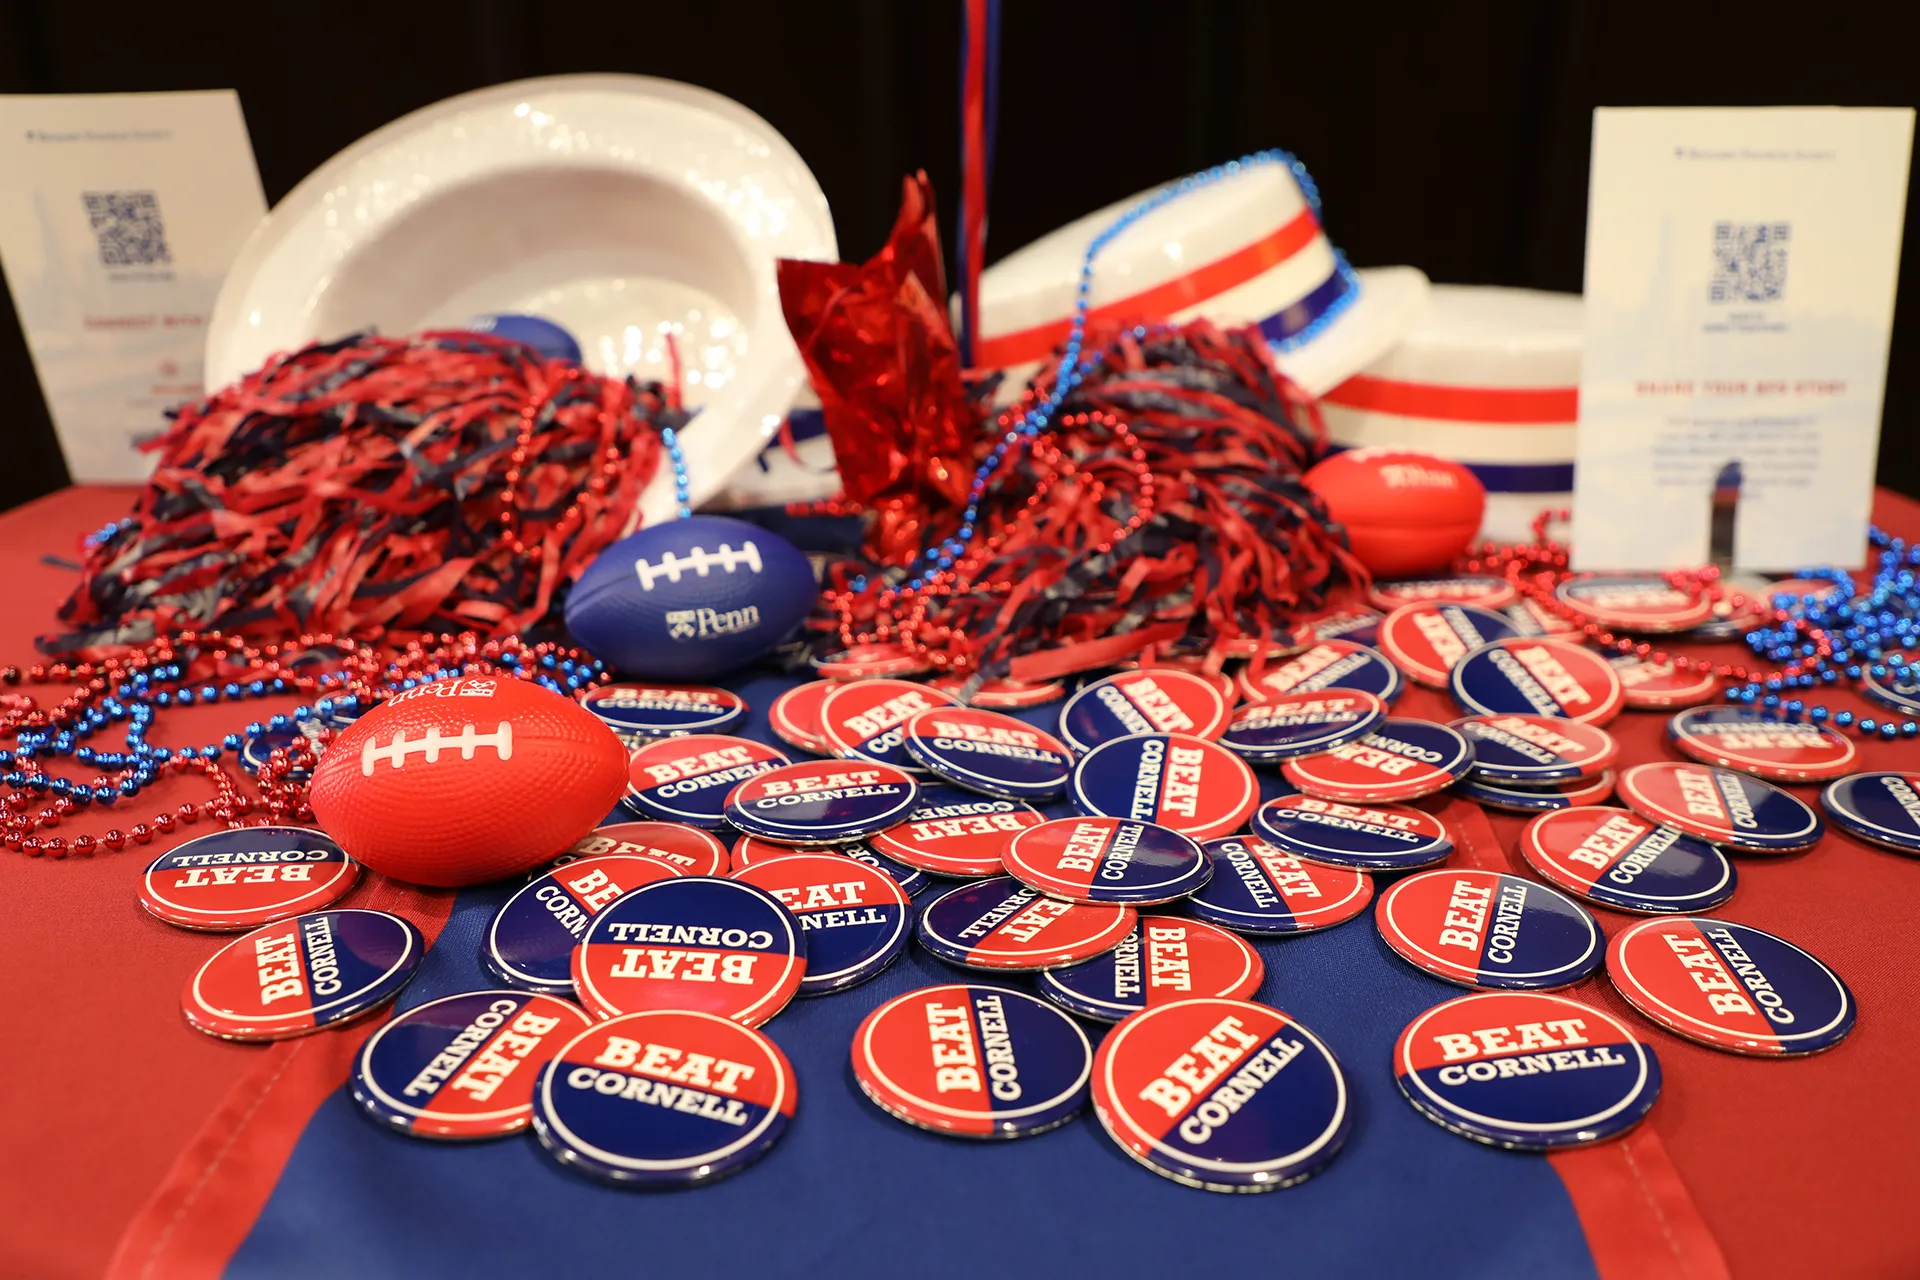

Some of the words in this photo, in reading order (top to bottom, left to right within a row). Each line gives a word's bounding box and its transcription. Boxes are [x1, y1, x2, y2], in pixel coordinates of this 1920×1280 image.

[697, 605, 760, 637] Penn
[388, 678, 465, 707] Penn
[611, 688, 719, 702] BEAT
[1515, 646, 1593, 705] BEAT
[597, 698, 724, 715] CORNELL
[843, 691, 932, 739] BEAT
[1096, 686, 1155, 733] CORNE
[1122, 677, 1195, 732] BEAT
[1229, 711, 1358, 732] CORNELL
[1245, 698, 1356, 720] BEAT
[931, 720, 1039, 749] BEAT
[933, 737, 1062, 764] CORNELL
[643, 745, 753, 784] BEAT
[657, 760, 780, 798] CORNELL
[761, 770, 881, 797] BEAT
[1130, 739, 1165, 820] CORNELL
[1161, 746, 1204, 818] BEAT
[756, 783, 900, 809] CORNELL
[911, 801, 1014, 821] CORNE
[1298, 798, 1420, 829] BEAT
[1674, 769, 1726, 820] BEAT
[1714, 773, 1758, 829] CORNELL
[910, 814, 1027, 842] BEAT
[1057, 822, 1112, 873] BEAT
[1276, 808, 1419, 843] CORNELL
[1568, 815, 1646, 870] BEAT
[172, 849, 329, 867] CORNELL
[174, 864, 314, 888] BEAT
[1101, 824, 1145, 880] CORNELL
[1220, 842, 1279, 909] CORNELL
[535, 885, 586, 940] CORN
[567, 868, 625, 912] BE
[768, 881, 866, 911] EAT
[958, 888, 1039, 939] ORNELL
[607, 922, 774, 950] CORNELL
[799, 907, 887, 931] NELL
[998, 898, 1075, 943] EAT
[1438, 879, 1492, 951] BEAT
[1488, 884, 1527, 964] CORNELL
[255, 933, 303, 1006] BEAT
[304, 916, 343, 996] CORNELL
[610, 948, 759, 985] BEAT
[1114, 927, 1140, 998] ORNELL
[1149, 926, 1192, 992] BEAT
[1662, 933, 1756, 1016] BEAT
[1707, 928, 1795, 1025] CORNELL
[403, 999, 518, 1098] CORNELL
[452, 1011, 561, 1101] BEAT
[926, 1002, 982, 1093] BEAT
[975, 995, 1022, 1102] CORNELL
[1433, 1018, 1589, 1061] BEAT
[594, 1036, 756, 1095] BEAT
[1138, 1015, 1259, 1118] BEAT
[1438, 1047, 1626, 1086] CORNELL
[567, 1066, 750, 1127] CORNELL
[1178, 1037, 1305, 1145] CORNELL
